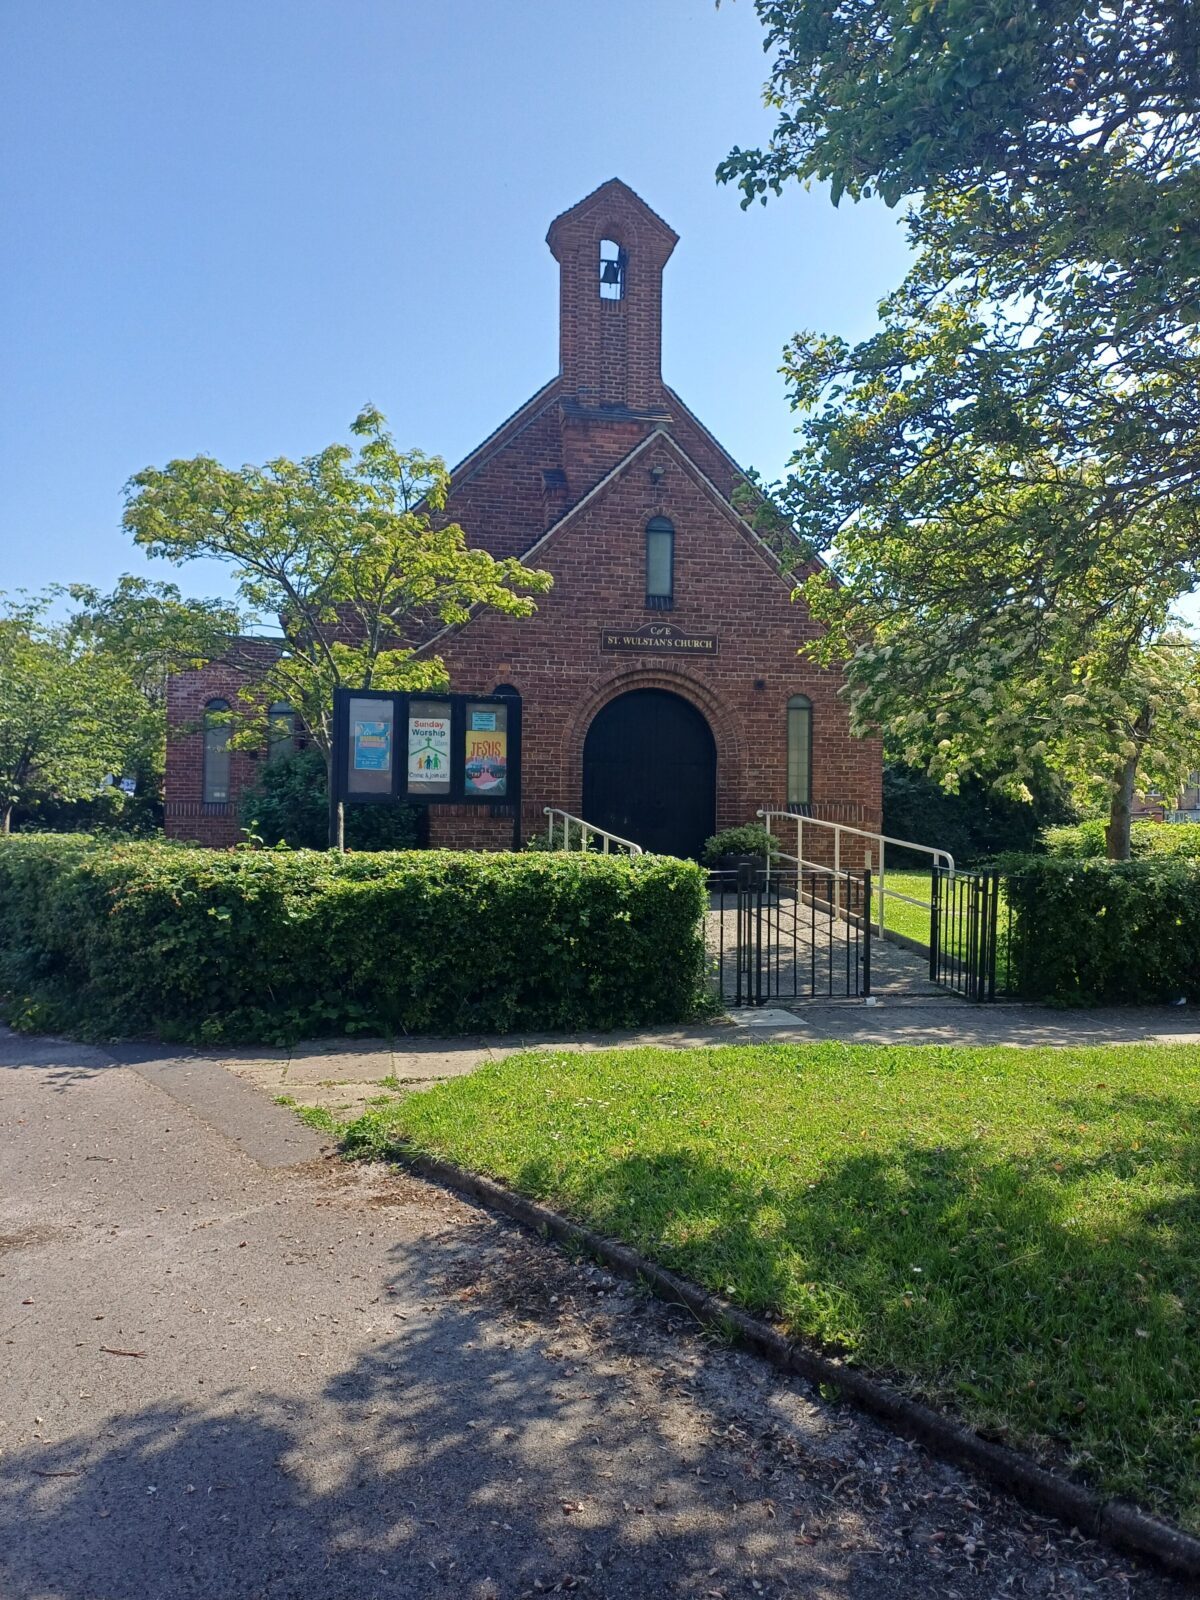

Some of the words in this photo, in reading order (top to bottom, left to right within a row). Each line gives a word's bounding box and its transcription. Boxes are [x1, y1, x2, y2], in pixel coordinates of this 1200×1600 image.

[607, 635, 621, 645] ST.
[623, 636, 673, 647] WULSTAN'S
[674, 639, 713, 649] CHURCH
[414, 720, 444, 729] Sunday
[411, 729, 446, 738] Worship
[470, 740, 502, 757] JESUS
